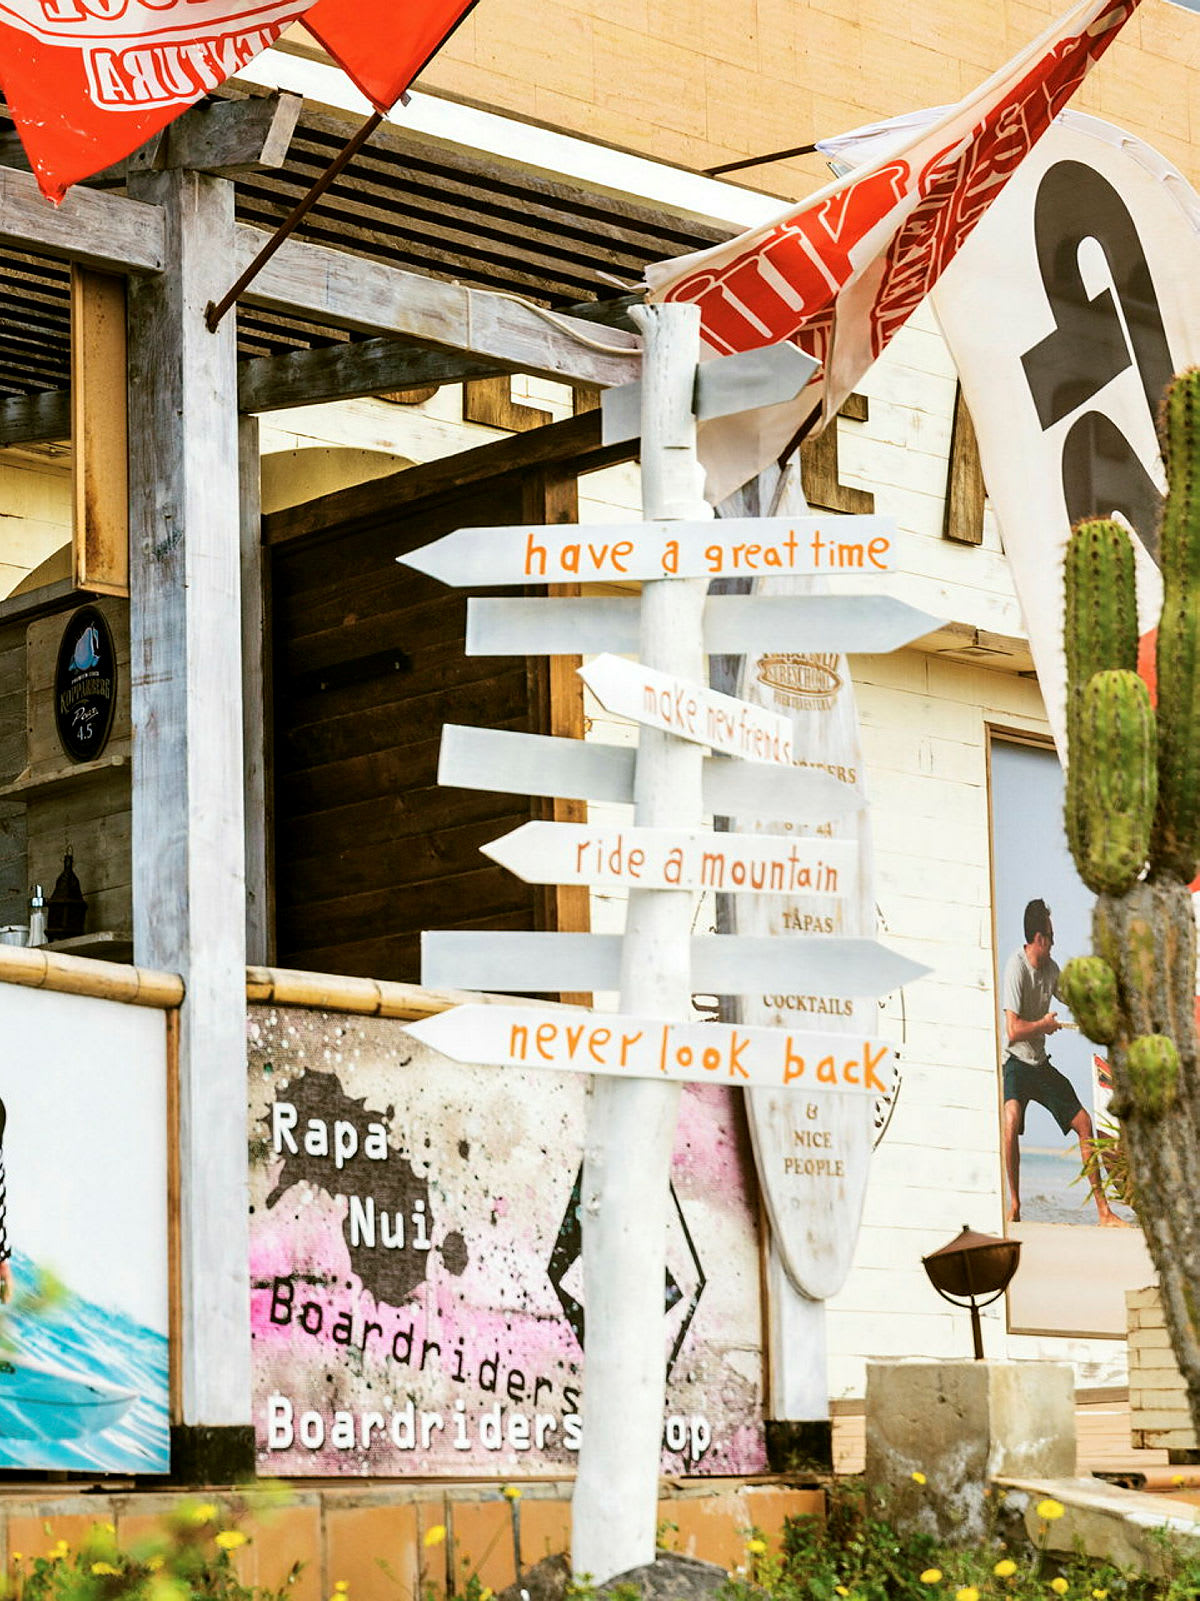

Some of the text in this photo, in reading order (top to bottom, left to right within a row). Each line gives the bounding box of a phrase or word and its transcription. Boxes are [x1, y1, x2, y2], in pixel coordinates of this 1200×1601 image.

[524, 530, 890, 575] have a great time
[77, 723, 93, 740] 4.5
[644, 681, 696, 734] make
[576, 835, 838, 892] ride a mountain
[763, 994, 853, 1017] COCKTAILS
[509, 1022, 892, 1093] never look back
[272, 1102, 390, 1168] Rapa
[793, 1130, 832, 1149] NICE
[784, 1157, 845, 1178] PEOPLE
[349, 1195, 433, 1252] Nui
[267, 1275, 581, 1416] Boardriders
[267, 1394, 583, 1453] Boardriders
